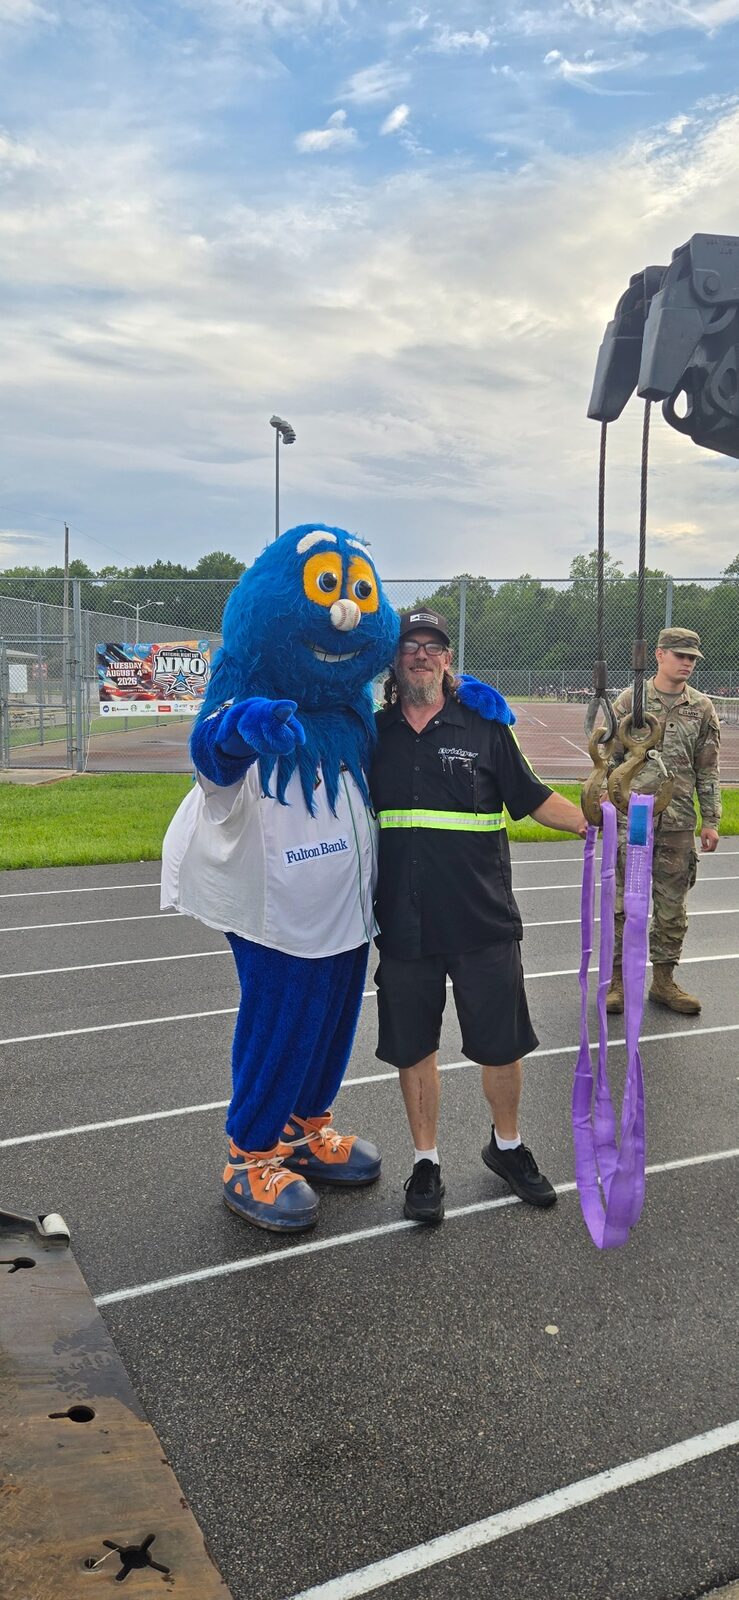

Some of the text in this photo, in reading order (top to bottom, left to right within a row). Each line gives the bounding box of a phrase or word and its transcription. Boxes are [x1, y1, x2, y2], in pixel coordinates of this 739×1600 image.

[156, 656, 204, 674] NNO
[106, 669, 135, 677] AUGUST
[118, 677, 138, 686] 2026
[286, 838, 348, 864] Fulton Bank
